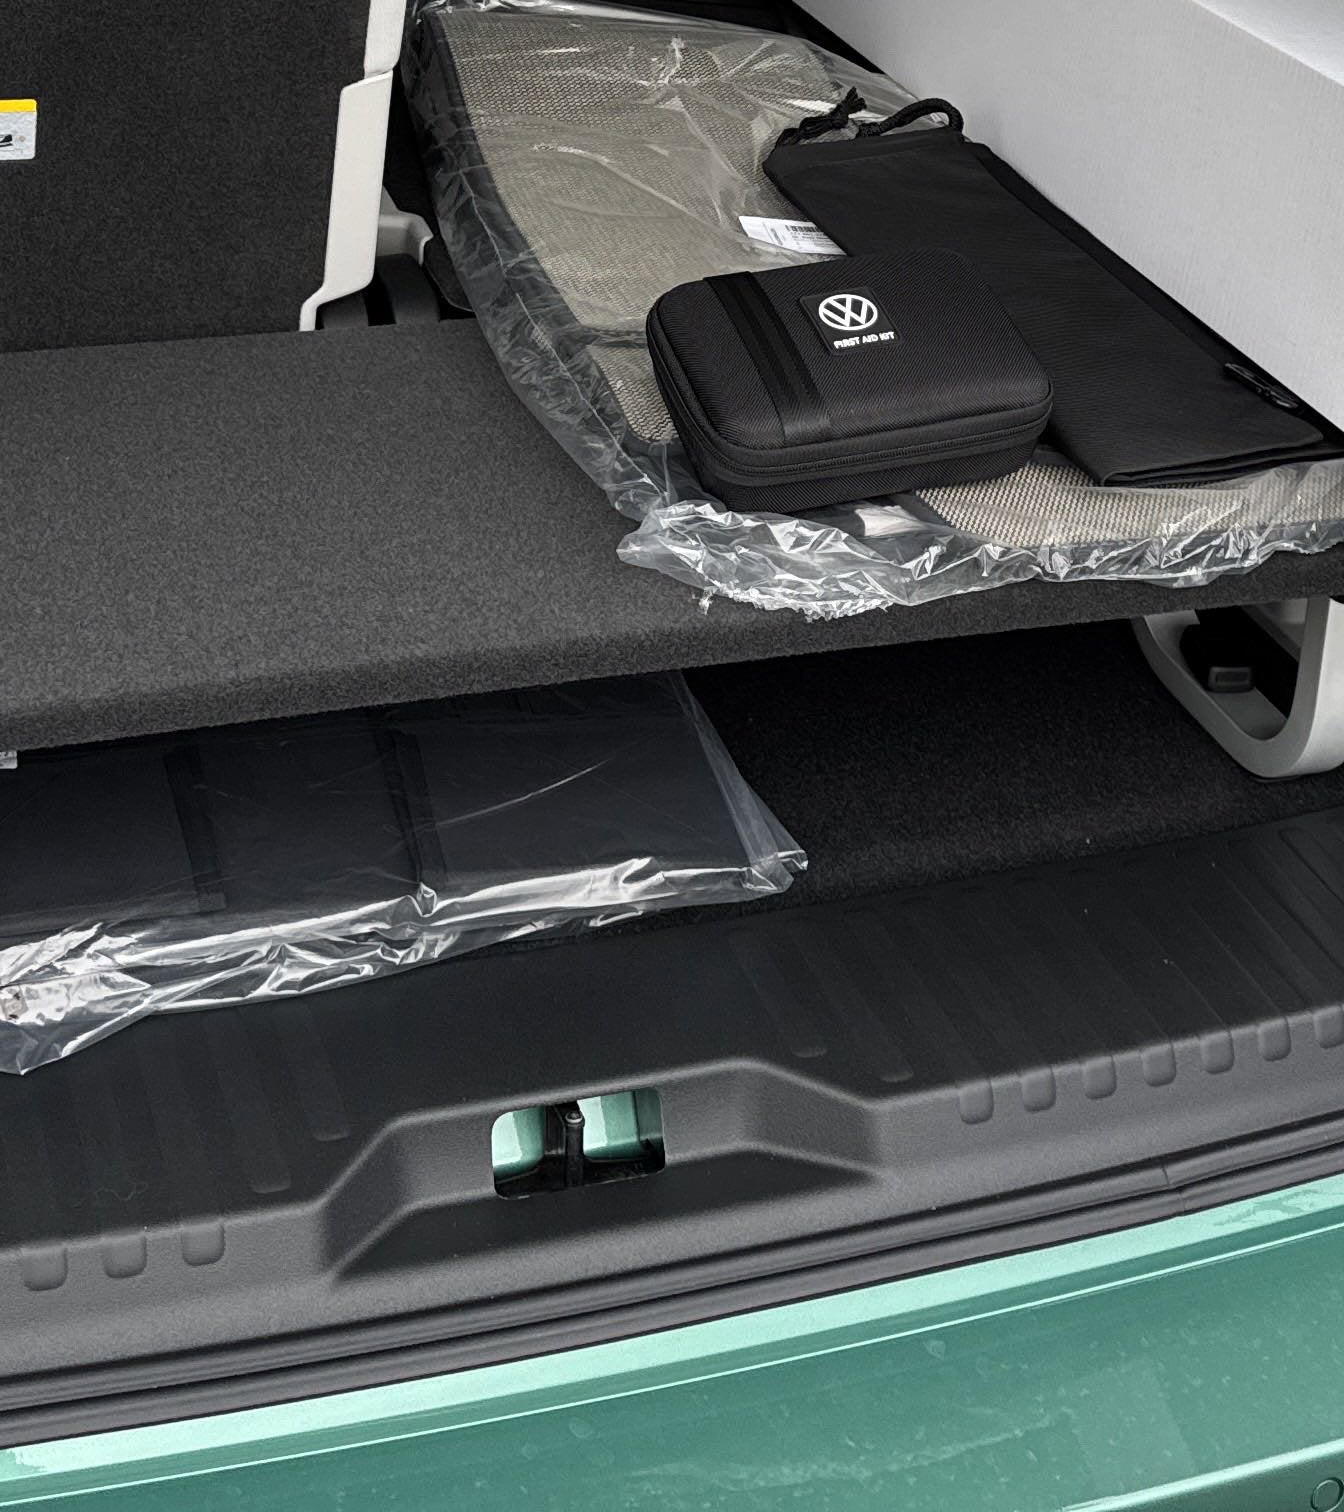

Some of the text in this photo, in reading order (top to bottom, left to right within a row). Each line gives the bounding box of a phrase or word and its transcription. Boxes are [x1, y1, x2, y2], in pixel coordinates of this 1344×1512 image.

[833, 331, 895, 349] FIRST AID KIT
